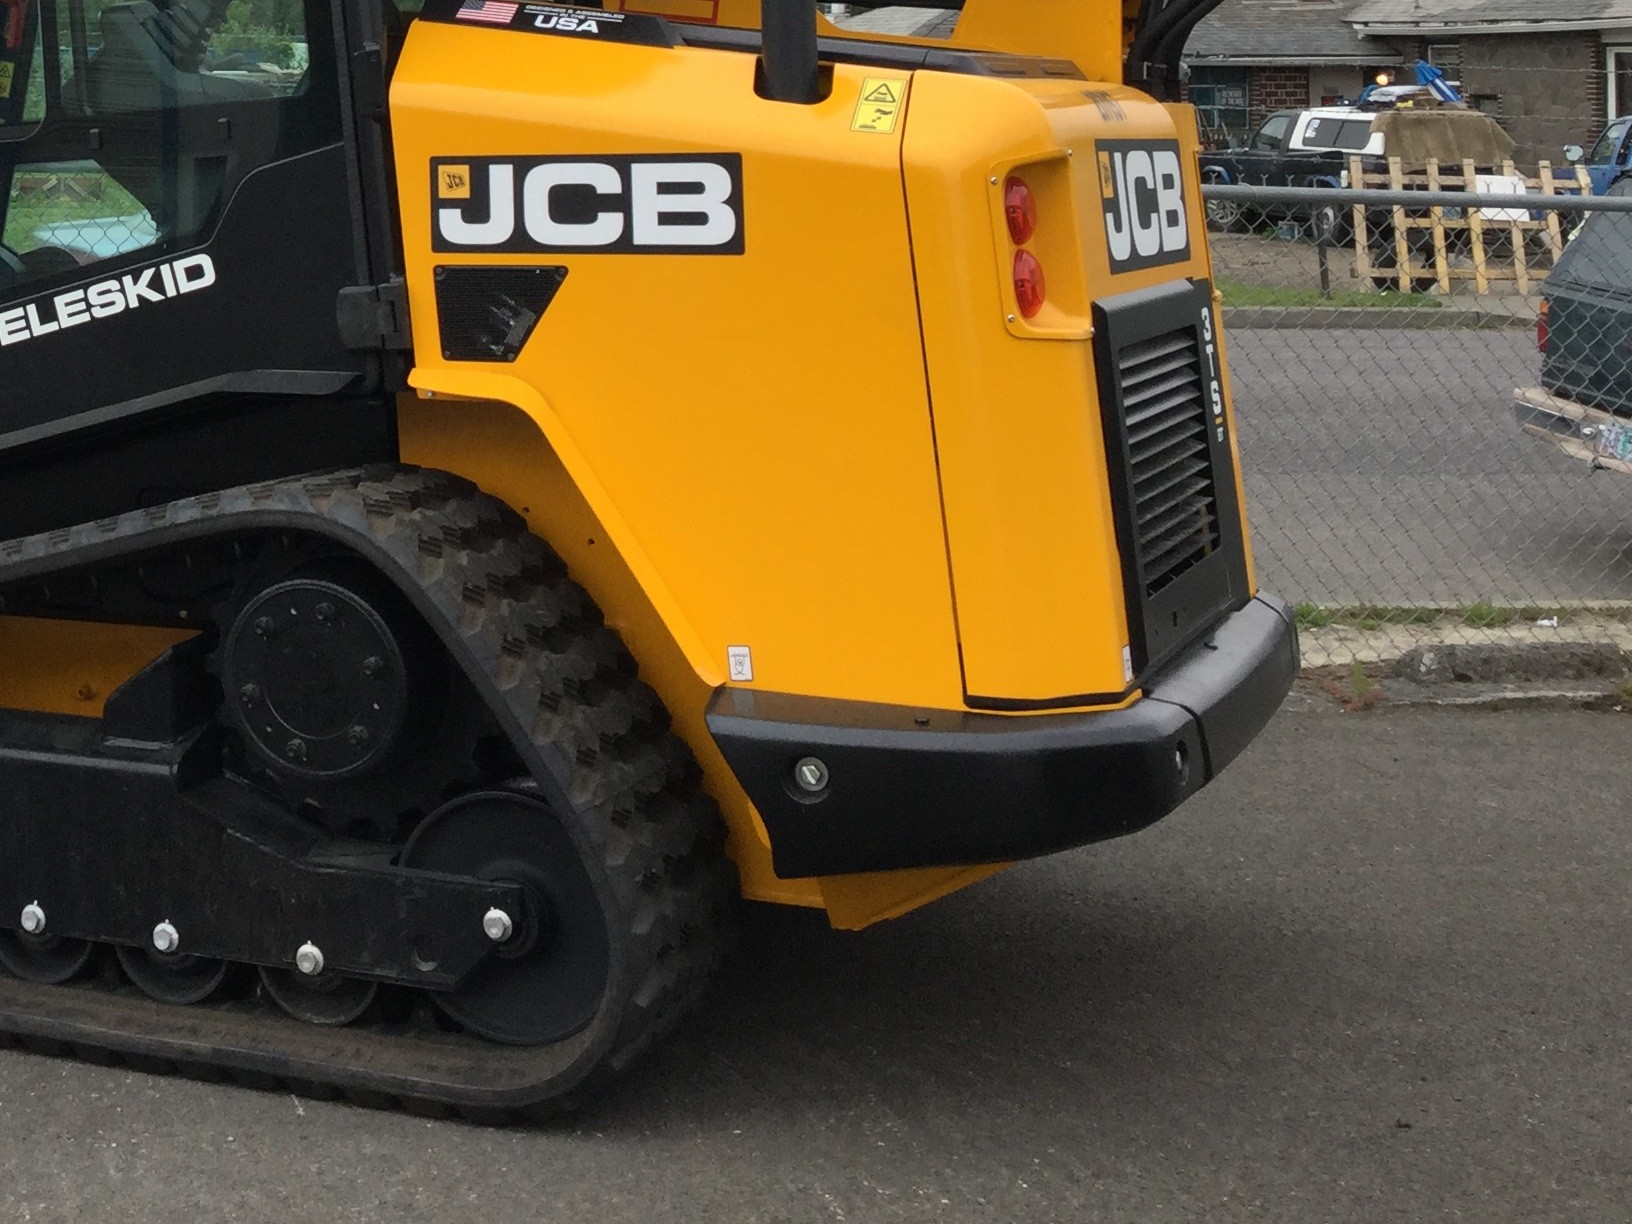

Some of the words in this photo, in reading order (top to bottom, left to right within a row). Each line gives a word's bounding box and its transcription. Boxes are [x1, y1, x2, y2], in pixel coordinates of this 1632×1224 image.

[534, 14, 599, 34] USA
[439, 162, 736, 246] JCB
[446, 172, 464, 189] JCB
[1105, 150, 1187, 261] JCB
